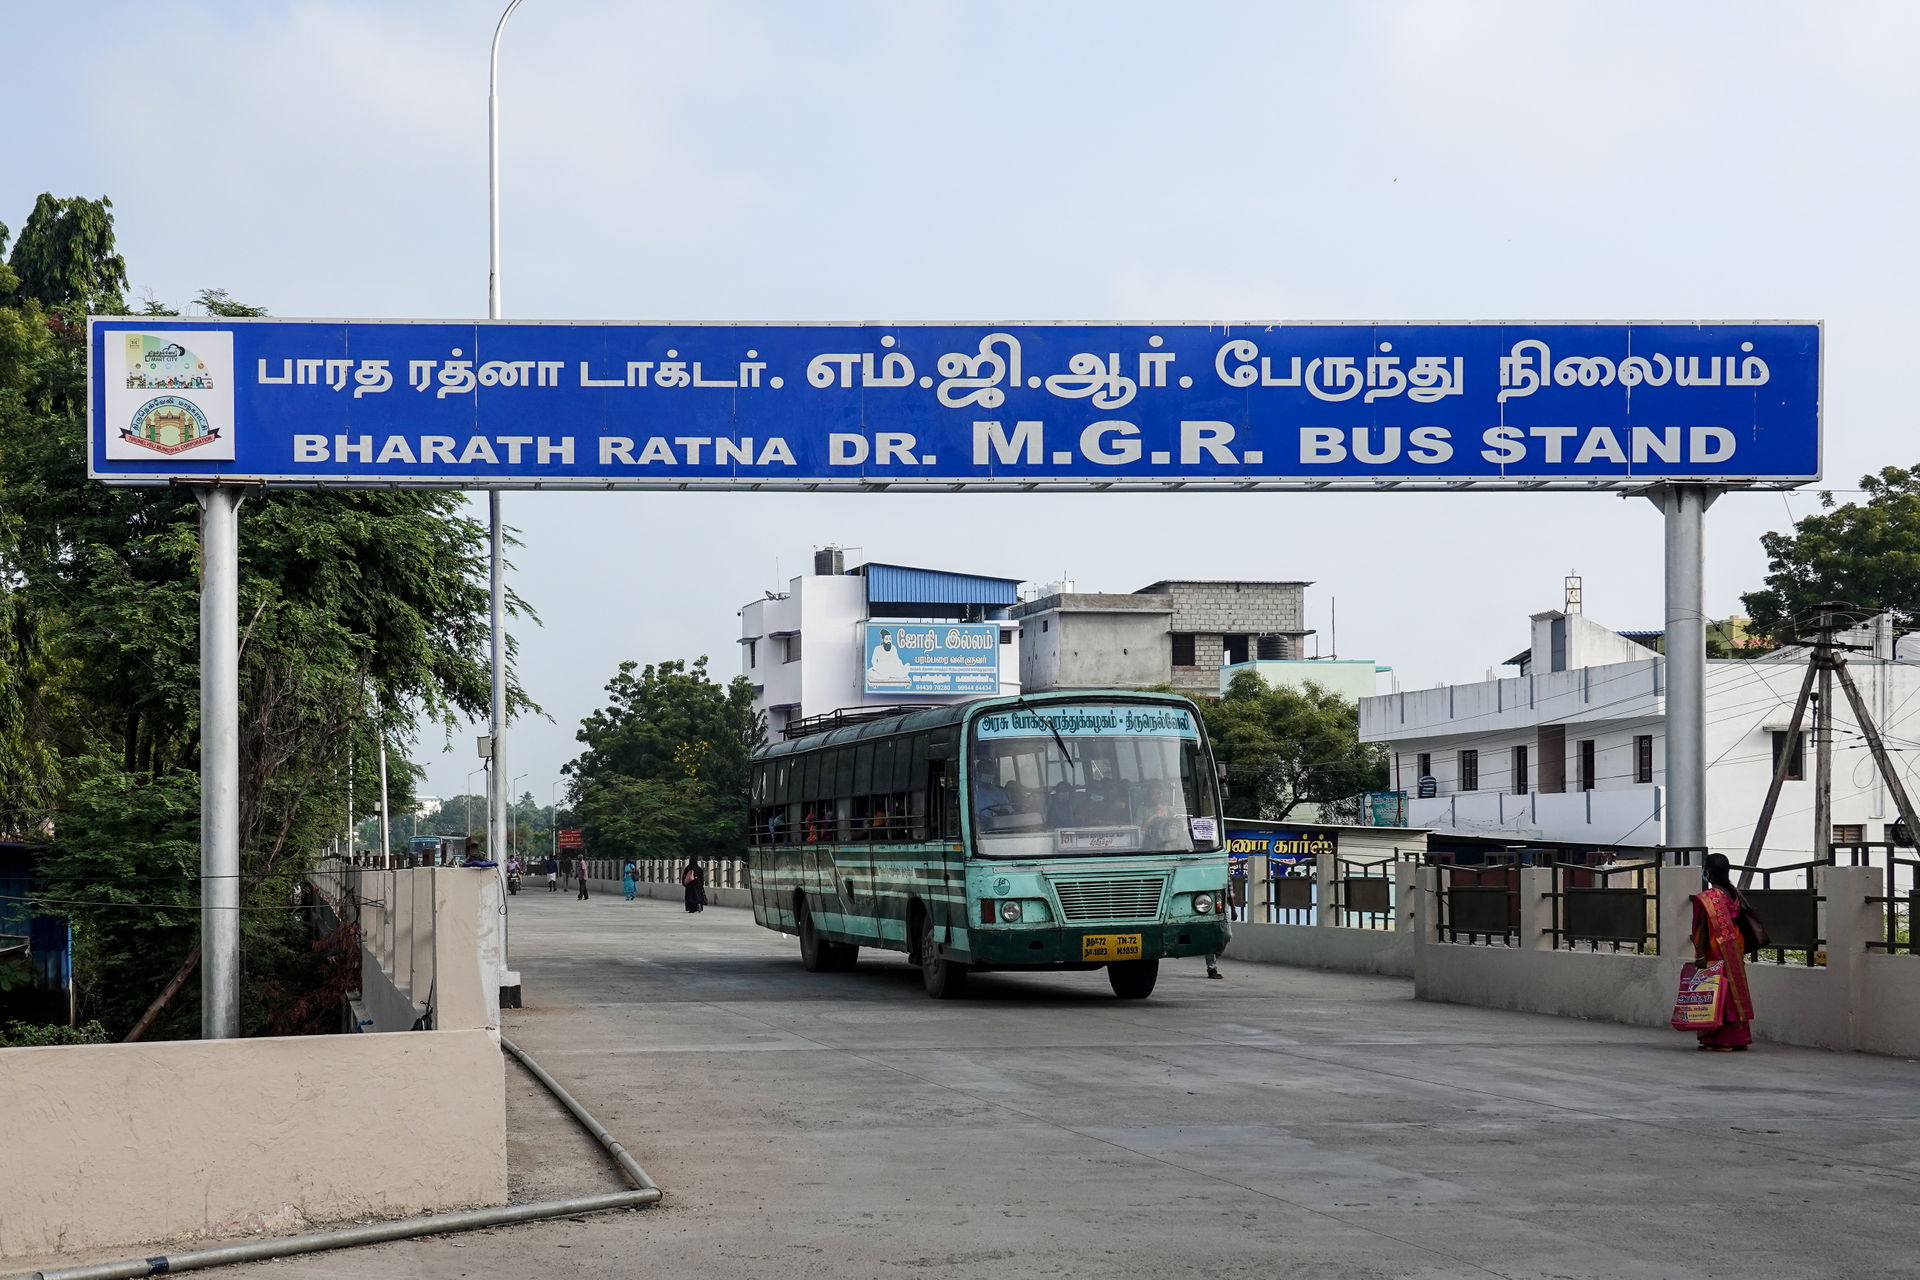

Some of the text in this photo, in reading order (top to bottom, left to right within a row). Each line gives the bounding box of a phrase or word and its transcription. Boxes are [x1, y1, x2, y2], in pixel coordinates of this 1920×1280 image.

[259, 332, 1770, 410] பாரத ரத்னா டாக்டர். எம்.ஜி.ஆர். பேருந்து நிலையம்
[180, 436, 213, 450] CORPORATION
[293, 420, 1738, 466] BHARATH RATNA DR. M.G.R. BUS STAND
[896, 628, 994, 654] ஜோதிட இல்லம்
[982, 716, 1009, 734] அரசு
[1125, 710, 1191, 732] திருநெல்வேலி
